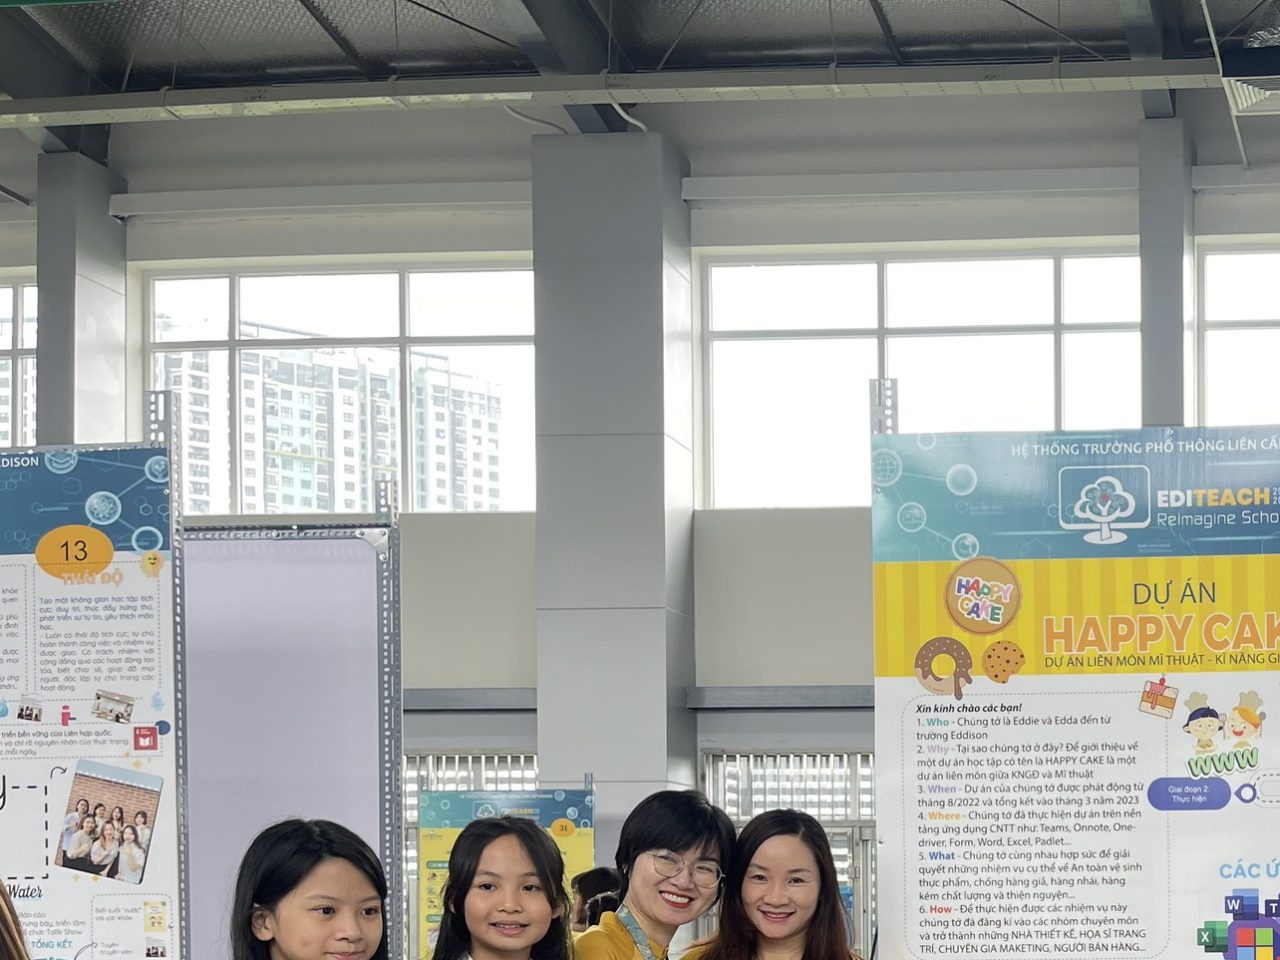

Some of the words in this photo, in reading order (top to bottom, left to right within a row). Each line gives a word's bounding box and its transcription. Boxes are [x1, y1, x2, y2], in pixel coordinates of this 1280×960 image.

[1012, 444, 1029, 457] HỆ
[1033, 441, 1080, 456] THỐNG
[1083, 441, 1142, 454] TRƯỜNG
[1146, 437, 1173, 453] PHỔ
[1177, 439, 1225, 451] THÔNG
[1228, 436, 1258, 450] LIÊN
[0, 457, 39, 467] DISON
[1157, 487, 1270, 508] EDITEACH
[1157, 512, 1236, 529] Reimagine
[60, 540, 87, 561] 13
[955, 576, 1013, 603] HAPPY
[1133, 580, 1173, 610] DỰ
[1180, 578, 1216, 604] ÁN
[958, 595, 1003, 624] CAKE
[1043, 613, 1194, 655] HAPPY
[1045, 654, 1064, 670] DỰ
[1067, 652, 1084, 667] ÁN
[1087, 652, 1112, 667] LIÊN
[1116, 652, 1145, 667] MÔN
[1149, 652, 1164, 666] MĨ
[1167, 651, 1205, 668] THUẬT
[1215, 651, 1227, 665] KĨ
[1230, 651, 1265, 664] NĂNG
[916, 704, 931, 713] Xin
[933, 704, 955, 713] kính
[957, 704, 981, 712] chào
[983, 704, 1001, 712] các
[1001, 703, 1022, 714] bạn!
[917, 718, 924, 727] 1.
[927, 717, 949, 727] Who
[957, 716, 989, 728] Chúng
[991, 717, 1001, 725] tớ
[1003, 717, 1011, 725] là
[1013, 716, 1040, 725] Eddie
[1041, 717, 1051, 725] và
[1055, 716, 1078, 725] Edda
[1080, 714, 1098, 725] đến
[1100, 716, 1111, 724] từ
[917, 731, 948, 741] trường
[951, 730, 988, 740] Eddison
[918, 838, 947, 848] driver,
[949, 838, 976, 848] Form,
[978, 837, 1005, 847] Word,
[1007, 837, 1033, 847] Excel,
[1219, 859, 1261, 879] CÁC
[1227, 899, 1240, 911] W
[1270, 903, 1278, 914] T
[1201, 931, 1210, 942] X
